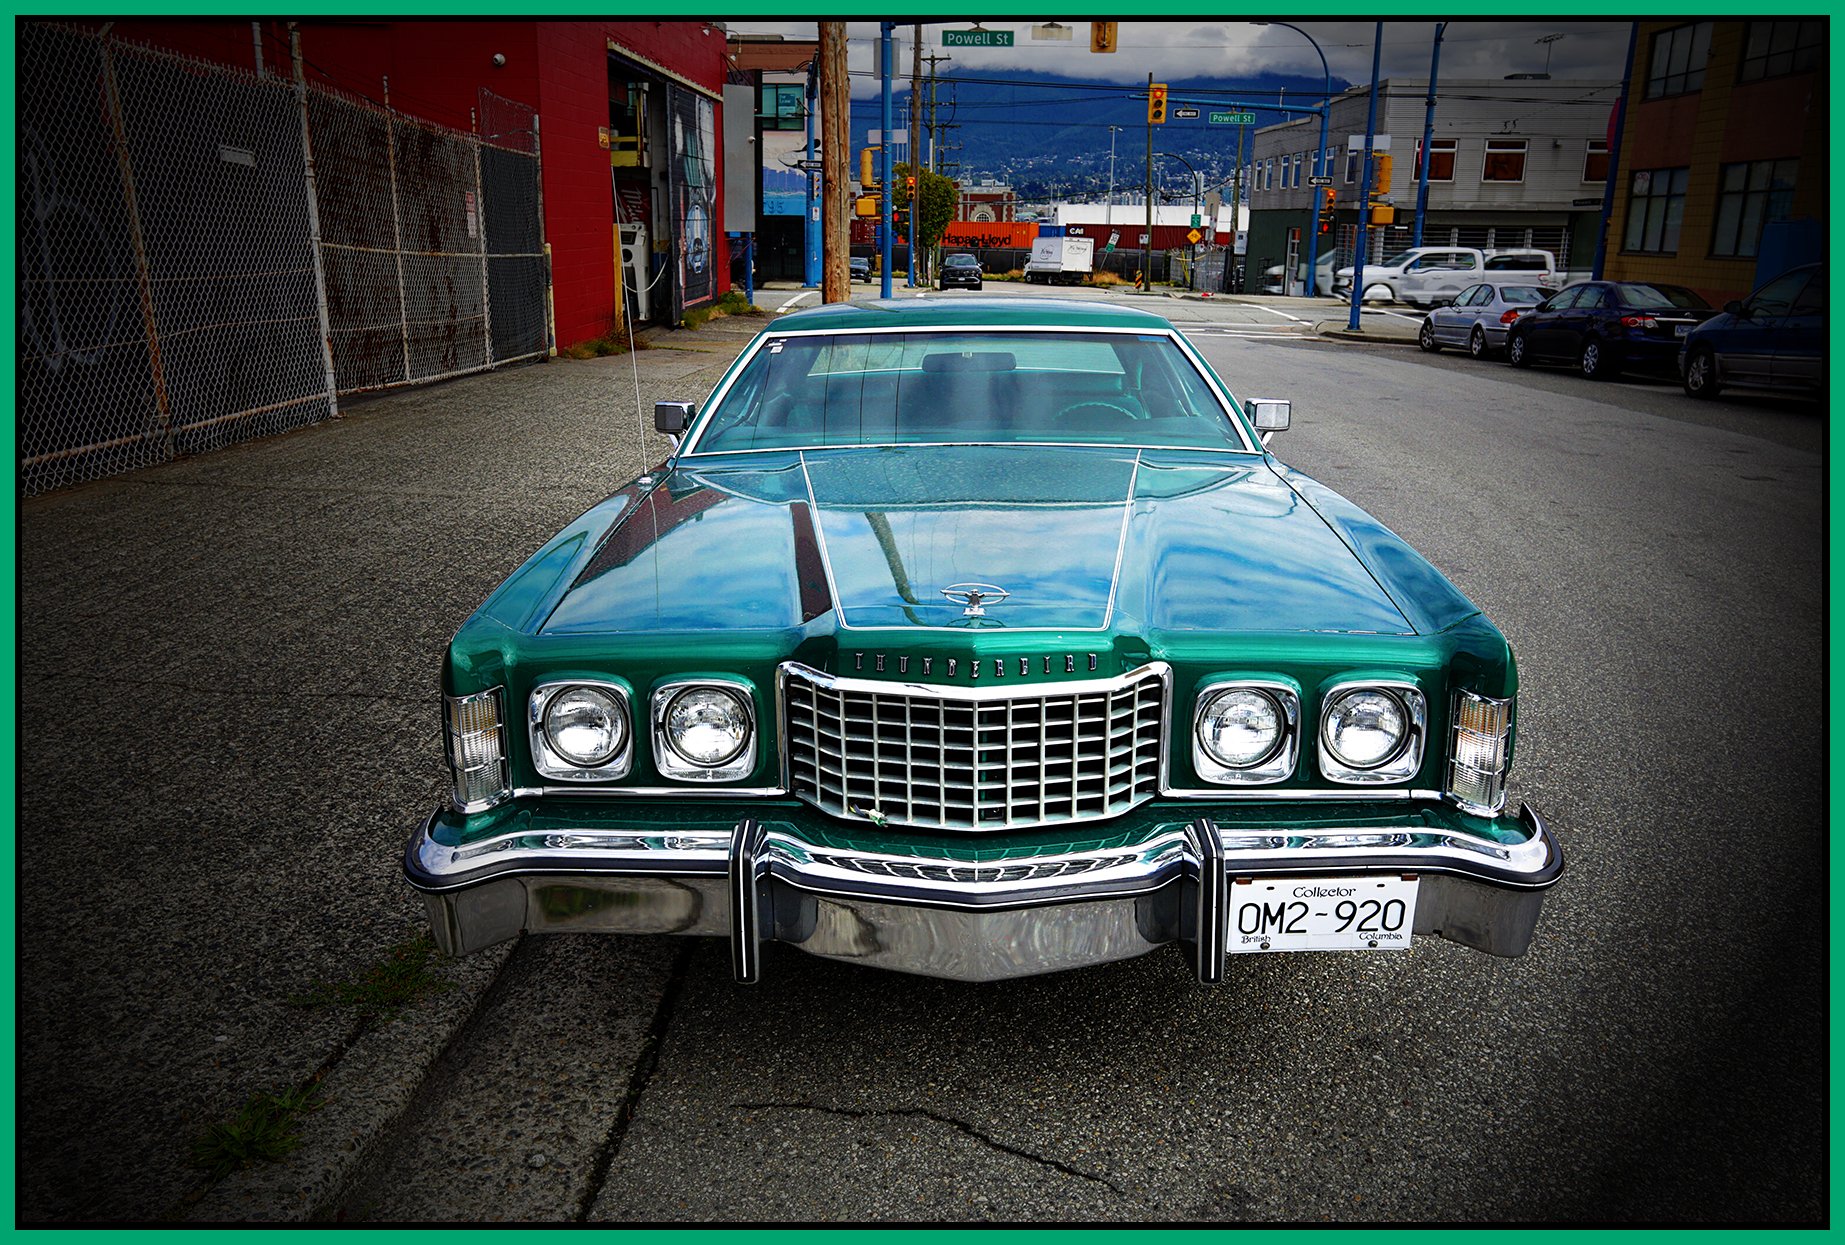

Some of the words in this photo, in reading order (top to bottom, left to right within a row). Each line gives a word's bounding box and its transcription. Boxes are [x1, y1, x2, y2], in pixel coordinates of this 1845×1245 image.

[948, 33, 991, 45] Powell
[996, 34, 1009, 45] St
[1213, 114, 1240, 123] Powell
[1243, 115, 1252, 123] St
[855, 653, 1098, 679] THUNDERBIRD
[1292, 886, 1357, 898] Collector
[1241, 934, 1271, 944] British
[1359, 931, 1403, 941] Columbia
